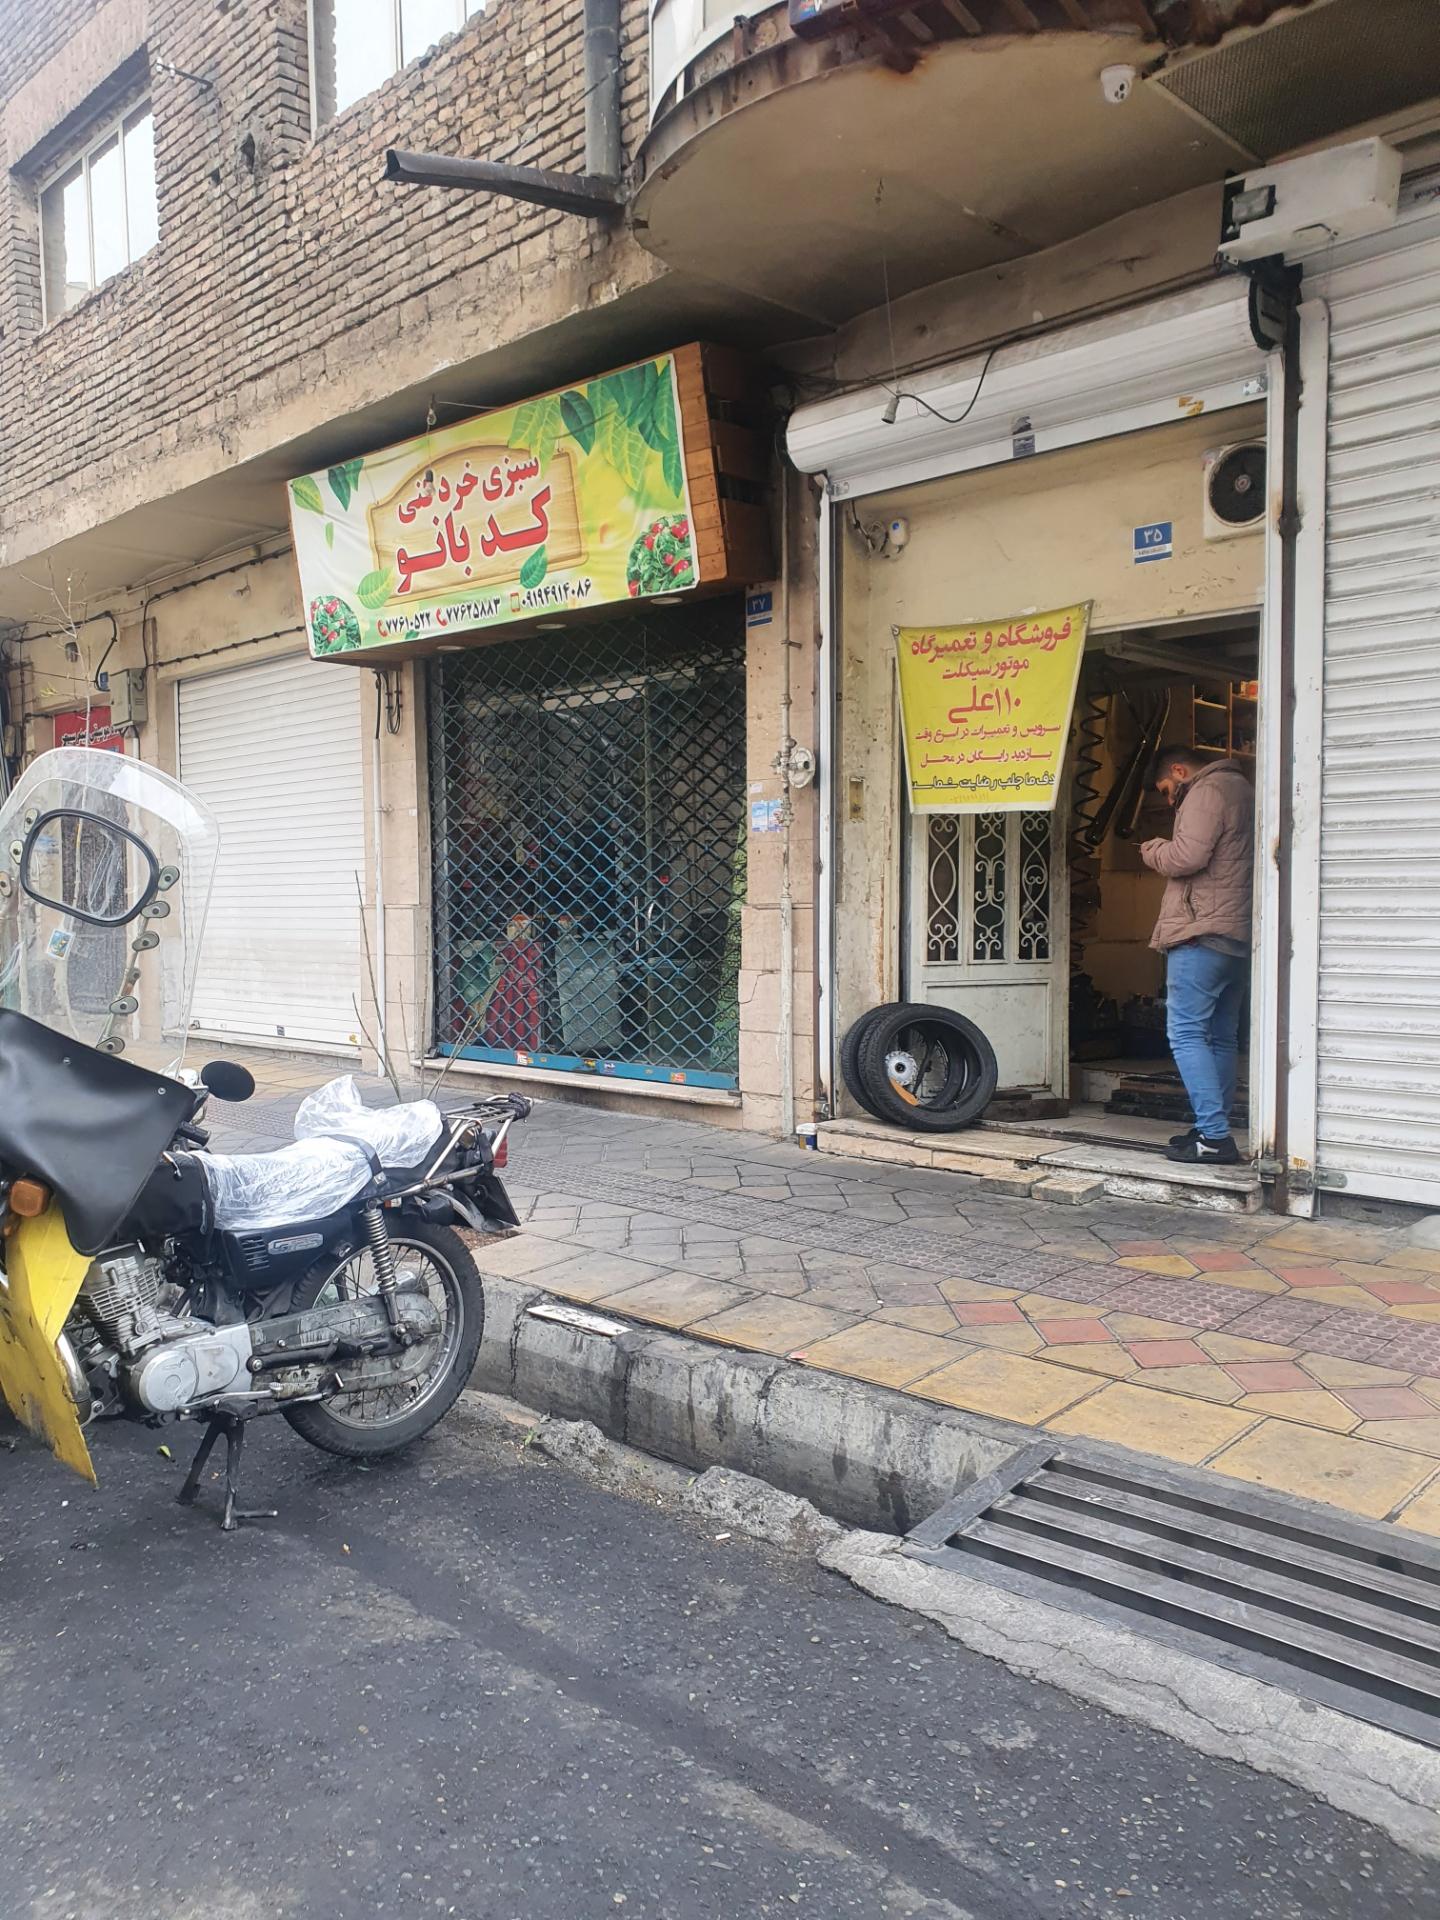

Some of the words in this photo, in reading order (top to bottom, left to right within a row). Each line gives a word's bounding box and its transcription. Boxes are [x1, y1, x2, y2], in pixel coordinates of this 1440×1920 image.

[482, 457, 539, 501] سبزی
[481, 485, 551, 557] کد
[1143, 527, 1163, 545] ۳۵
[397, 511, 471, 594] بانو
[980, 630, 993, 654] و
[997, 616, 1072, 651] فروشگاه
[911, 630, 977, 663] تعمیرگاه
[959, 728, 969, 740] در
[970, 724, 1010, 740] تعمیرات
[1011, 725, 1018, 738] و
[1019, 724, 1062, 738] سرویس
[920, 753, 955, 768] محل
[955, 751, 965, 765] در
[966, 749, 1009, 764] رایگان
[1011, 747, 1052, 762] بازدید
[958, 774, 998, 792] رضایت
[998, 771, 1024, 791] جلب
[1023, 773, 1037, 786] ما
